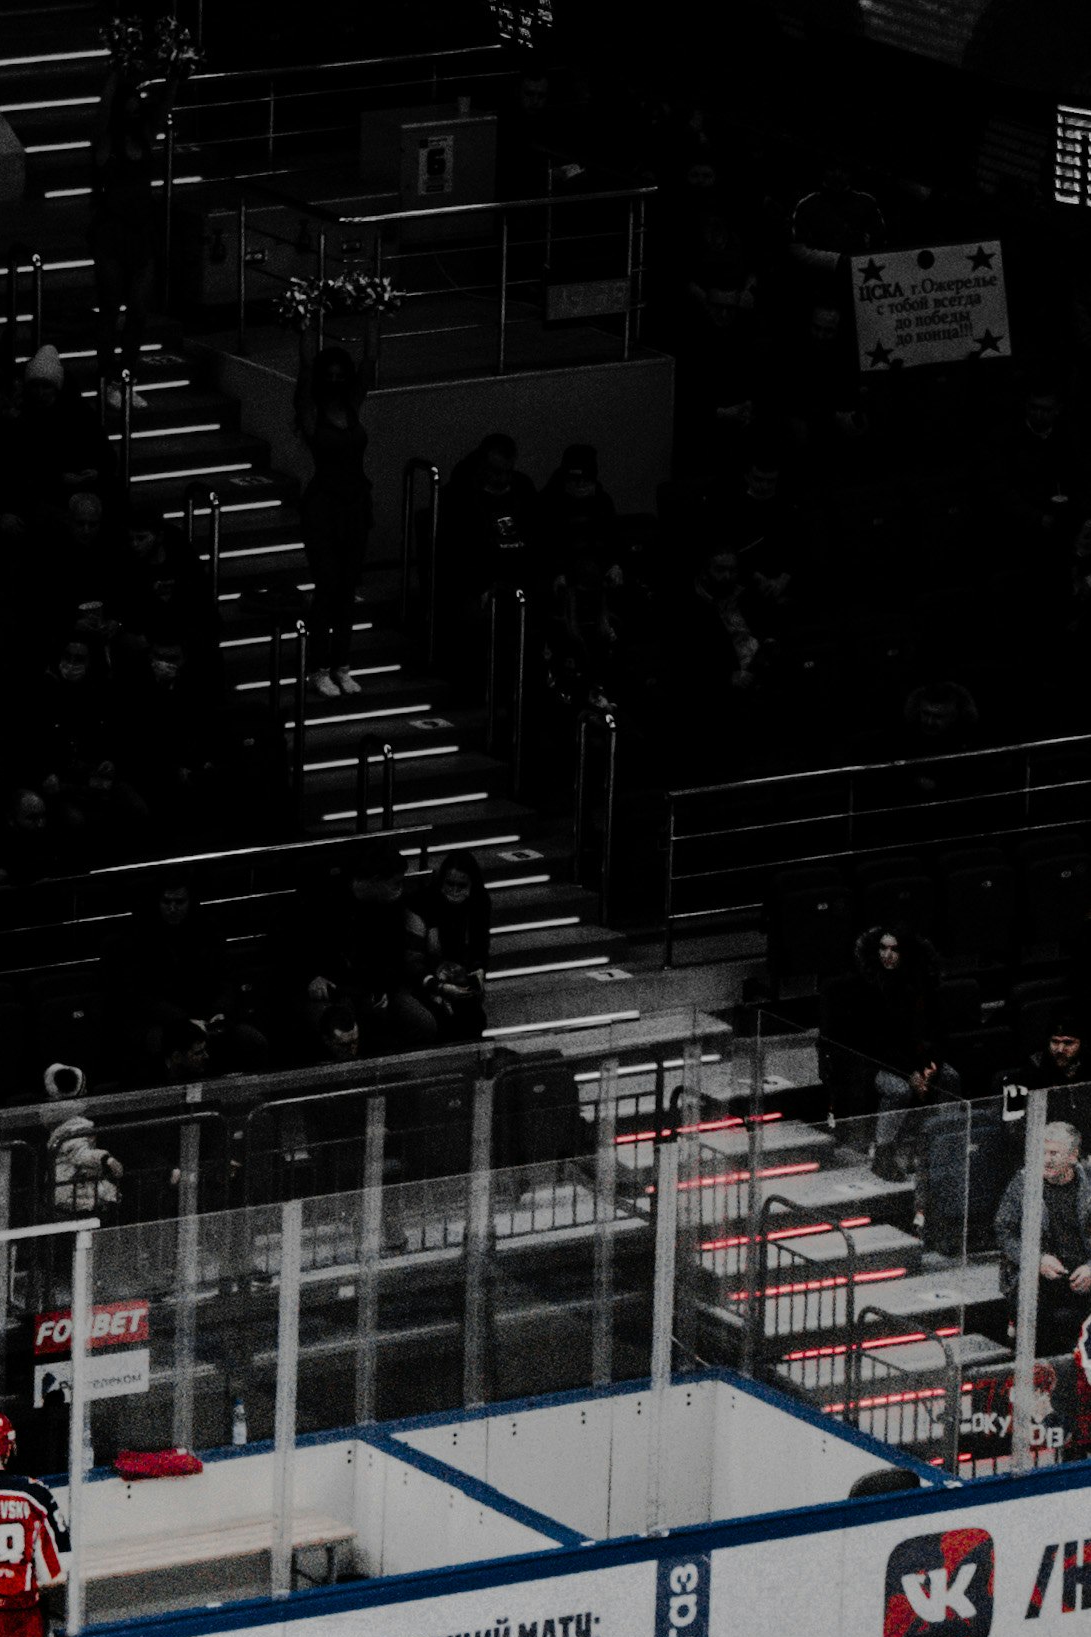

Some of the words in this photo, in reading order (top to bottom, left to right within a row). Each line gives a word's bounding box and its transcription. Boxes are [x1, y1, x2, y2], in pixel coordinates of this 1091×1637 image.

[427, 148, 446, 176] 6
[859, 282, 904, 303] ЦСКА
[876, 305, 885, 317] с
[888, 298, 930, 315] тобой
[933, 293, 982, 309] всегда
[894, 318, 912, 332] до
[915, 310, 971, 326] победы
[896, 333, 913, 347] до
[916, 322, 973, 342] конца!!!
[36, 1309, 147, 1346] FOBET
